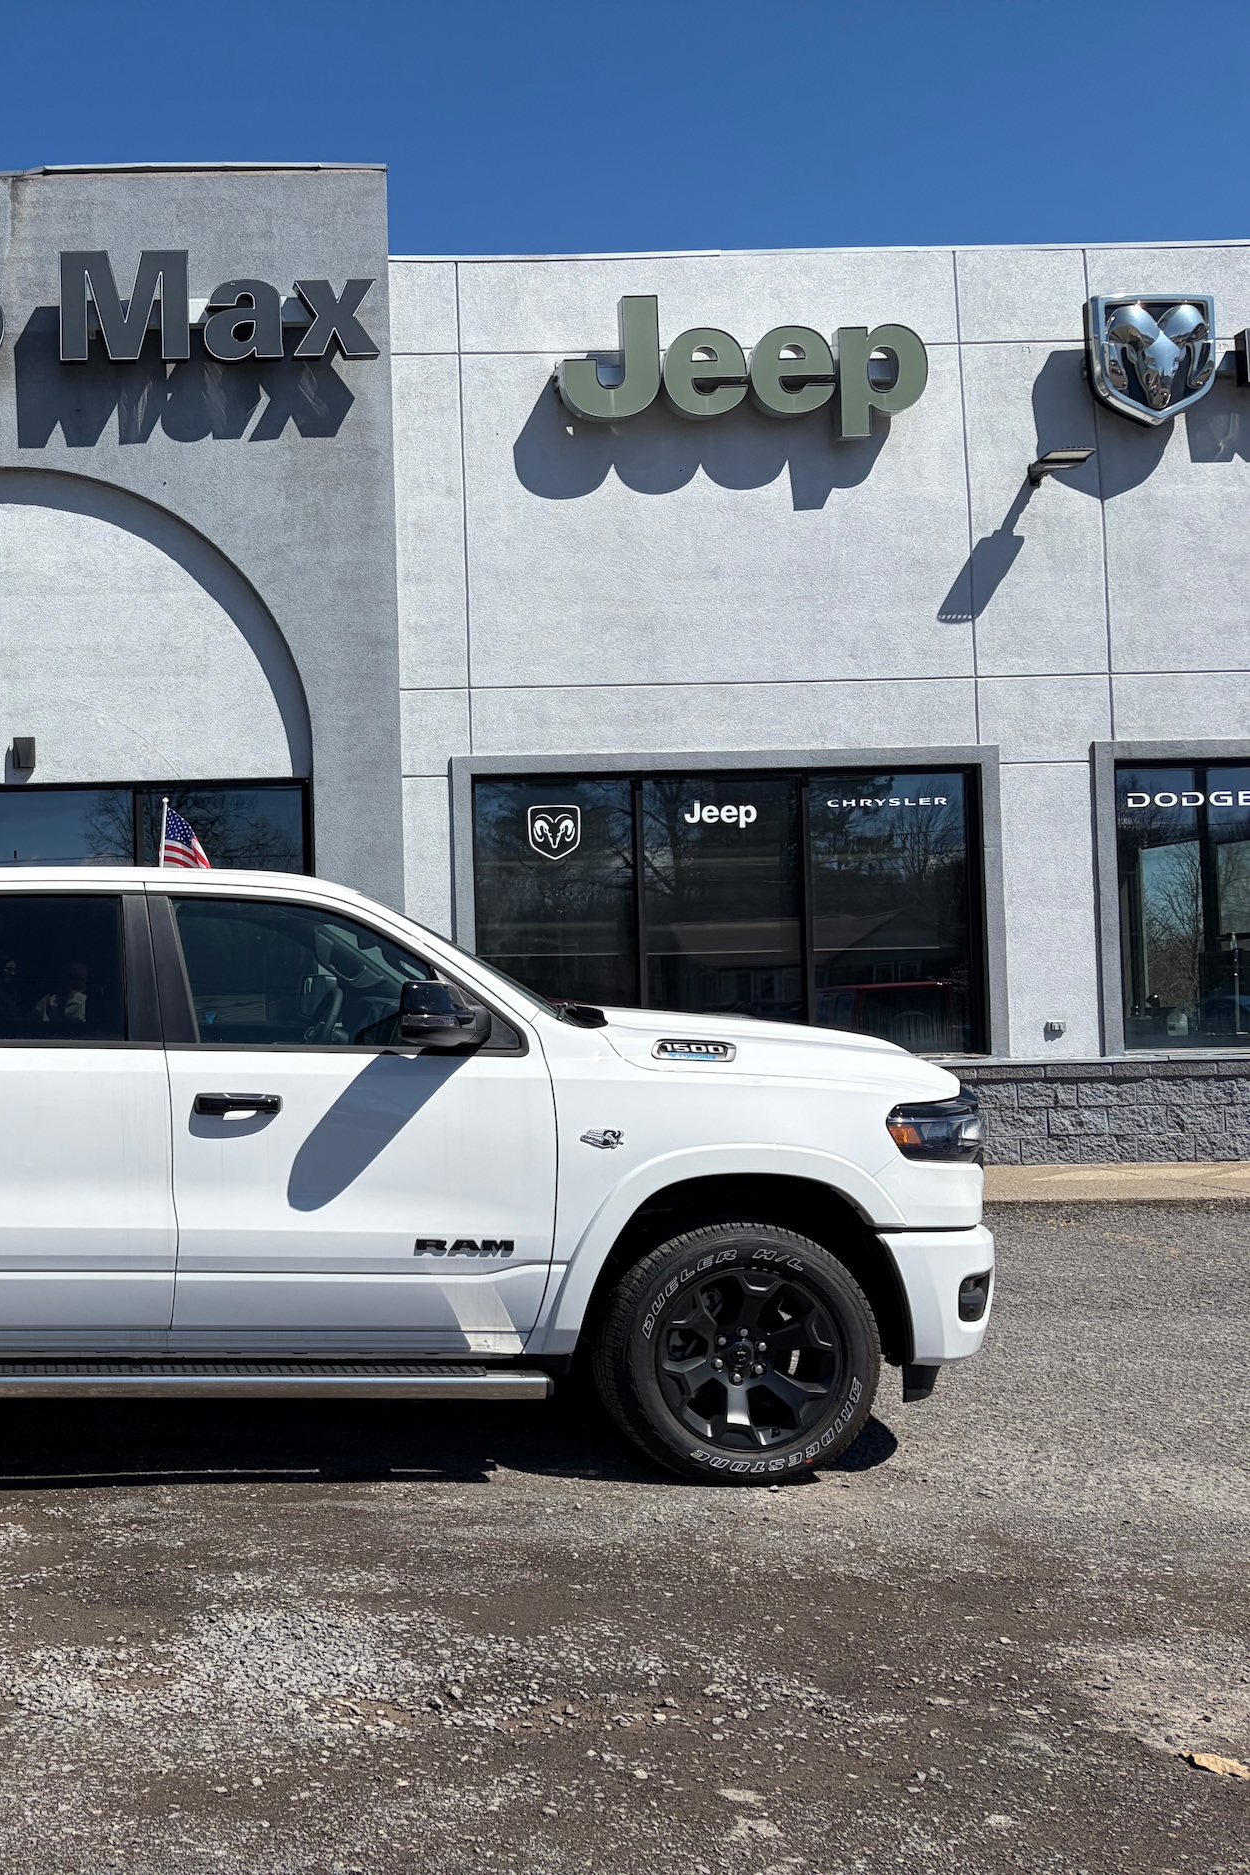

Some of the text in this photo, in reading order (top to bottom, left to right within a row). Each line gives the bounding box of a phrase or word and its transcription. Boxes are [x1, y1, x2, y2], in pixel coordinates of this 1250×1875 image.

[58, 249, 381, 364] Max
[558, 295, 928, 440] Jeep
[827, 797, 948, 808] CHRYSLER
[1127, 791, 1250, 808] DODGE
[684, 800, 757, 828] Jeep
[661, 1043, 725, 1054] 1500
[415, 1238, 515, 1253] RAM
[642, 1248, 804, 1340] DUELER H/L
[689, 1376, 863, 1474] BRIDGESTONE
